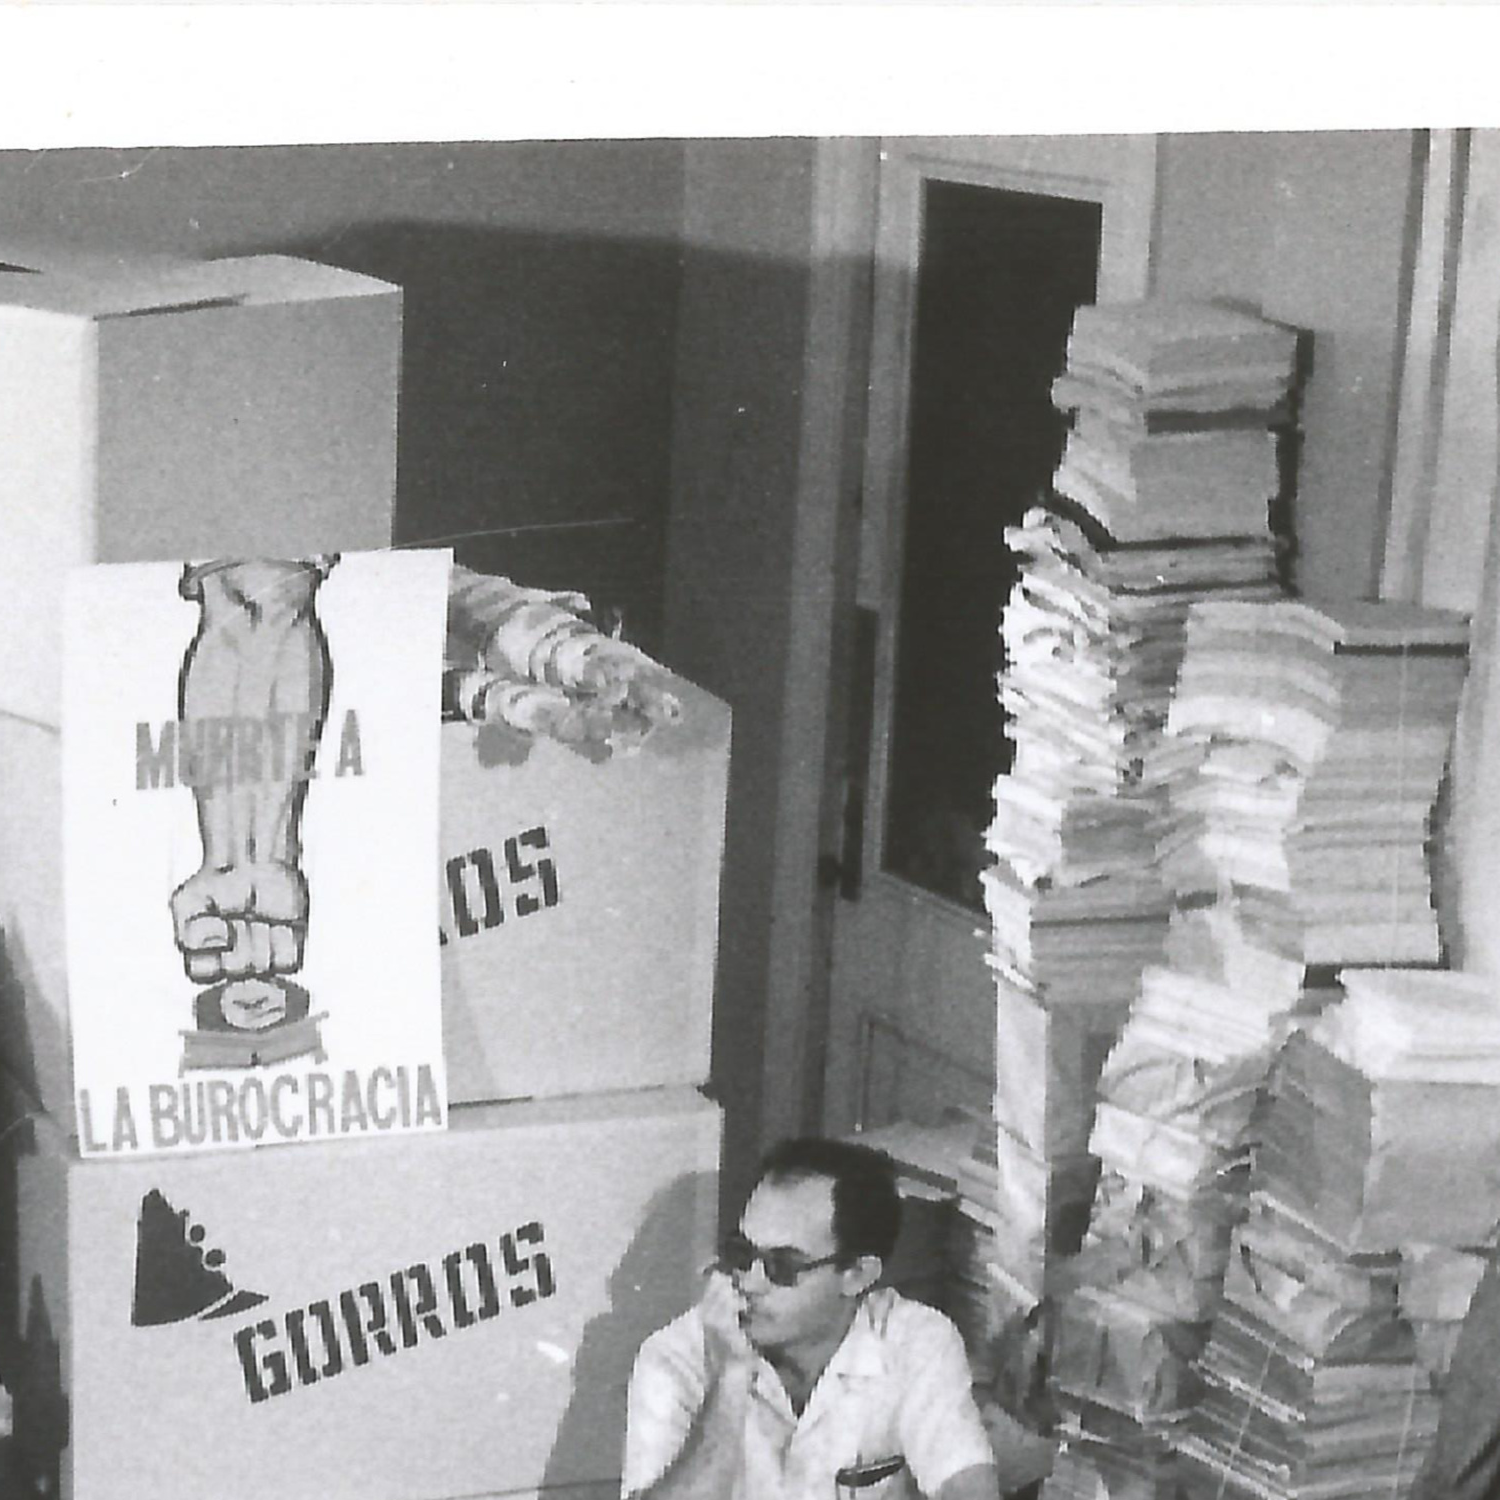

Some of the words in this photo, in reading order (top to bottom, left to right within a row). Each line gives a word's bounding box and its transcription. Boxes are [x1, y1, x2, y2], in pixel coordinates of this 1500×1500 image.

[334, 708, 364, 778] A
[439, 825, 561, 946] OS
[78, 1086, 139, 1152] LA
[148, 1062, 443, 1149] BUROCRACIA
[233, 1221, 556, 1403] GORROS
